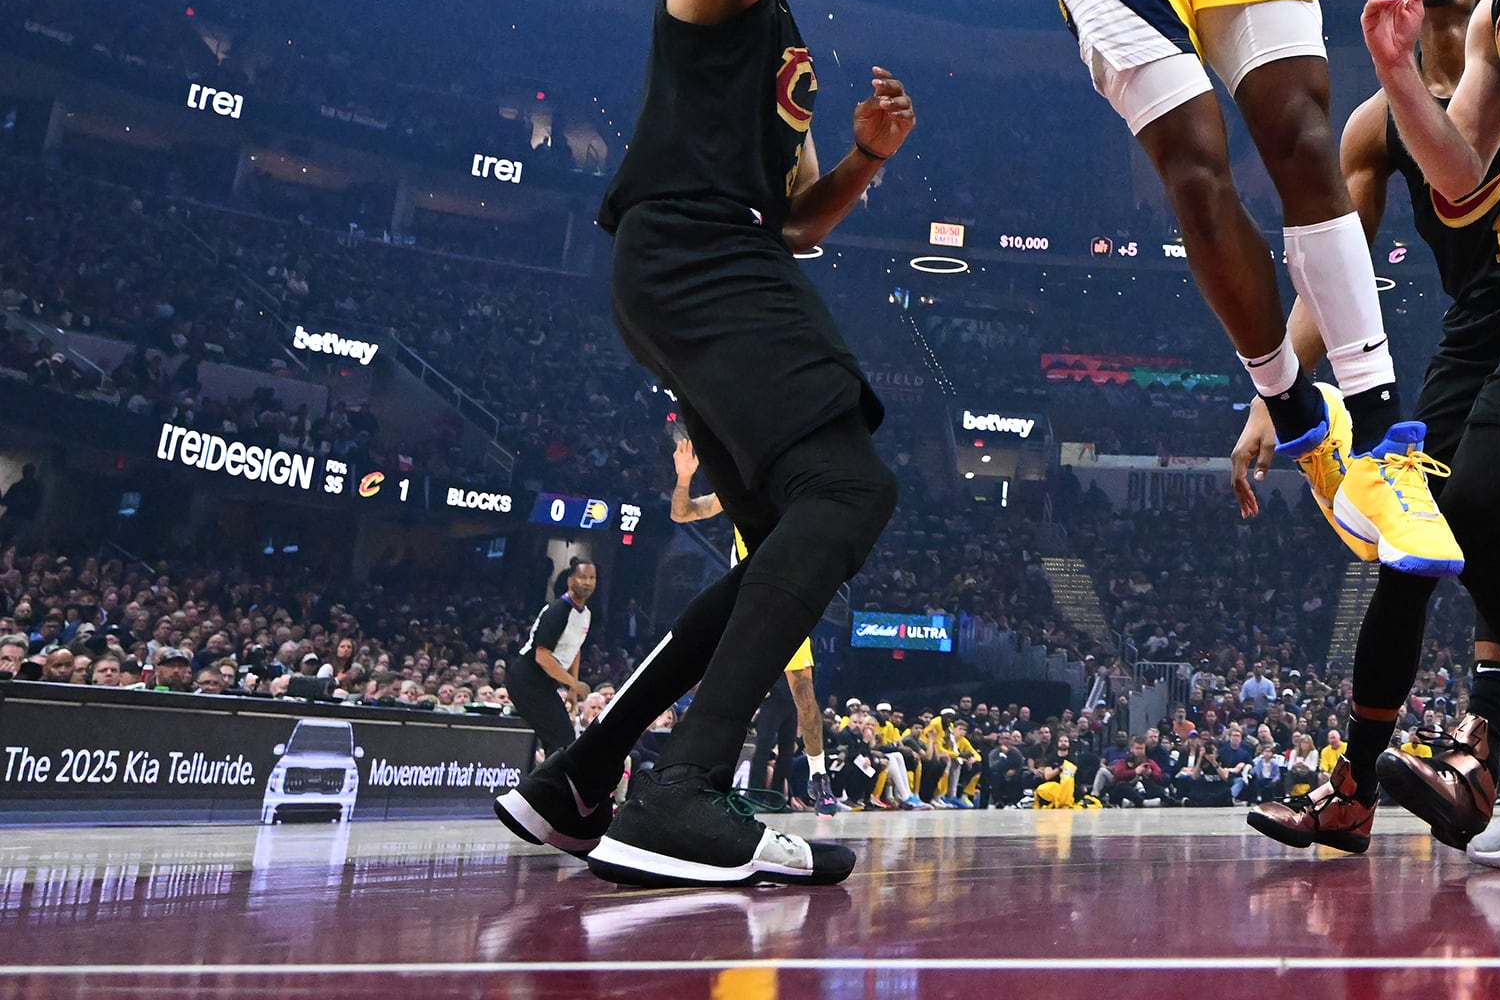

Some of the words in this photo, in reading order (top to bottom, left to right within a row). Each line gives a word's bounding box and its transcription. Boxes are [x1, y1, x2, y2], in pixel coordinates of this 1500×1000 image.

[1000, 234, 1049, 251] $10,000
[293, 326, 378, 365] betway
[962, 410, 1035, 438] betway
[323, 476, 343, 494] 35
[399, 479, 409, 502] 1
[446, 487, 513, 513] BLOCKS
[550, 499, 565, 522] 0
[620, 516, 640, 532] 27
[907, 626, 947, 639] ULTRA
[5, 747, 50, 782] The
[56, 749, 117, 783] 2025
[123, 751, 158, 783] Kia
[168, 753, 256, 785] Telluride.
[369, 758, 443, 787] Movement
[448, 762, 472, 787] that
[475, 764, 520, 793] inspires
